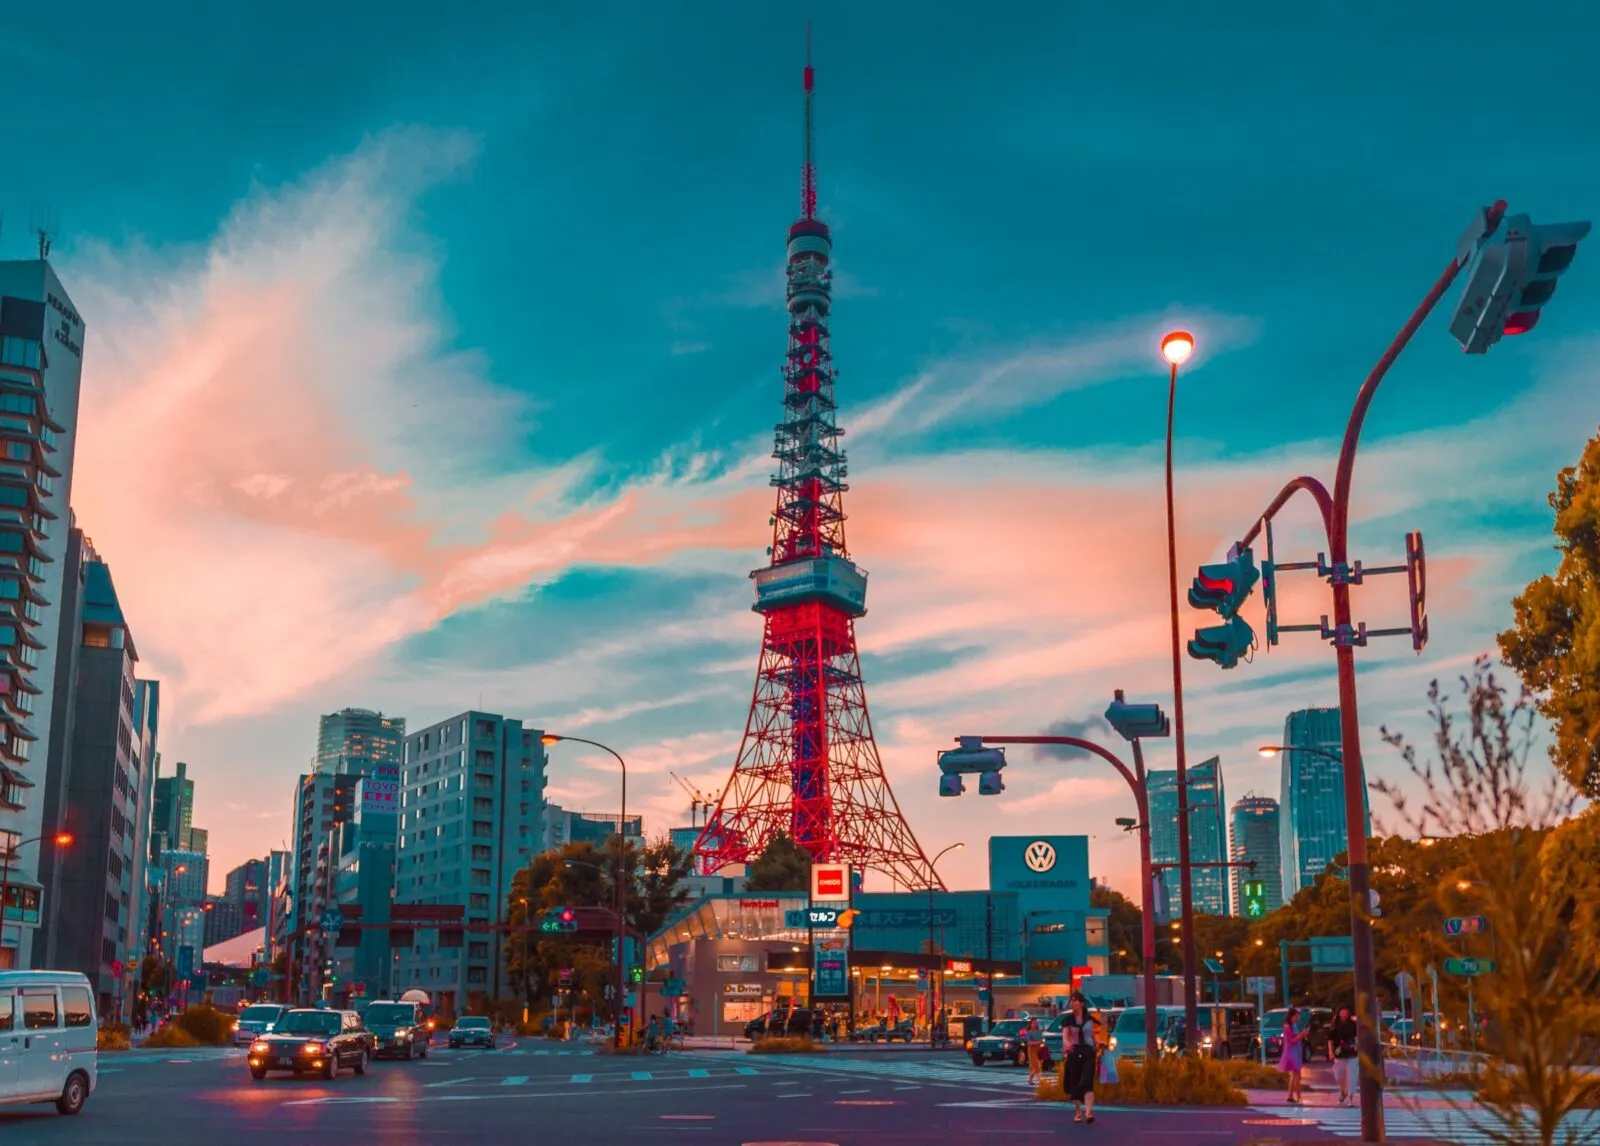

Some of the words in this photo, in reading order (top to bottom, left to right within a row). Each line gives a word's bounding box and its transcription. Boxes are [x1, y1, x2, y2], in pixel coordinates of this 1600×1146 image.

[1007, 879, 1078, 889] VOLKSWAGEN
[809, 912, 836, 922] セルフ
